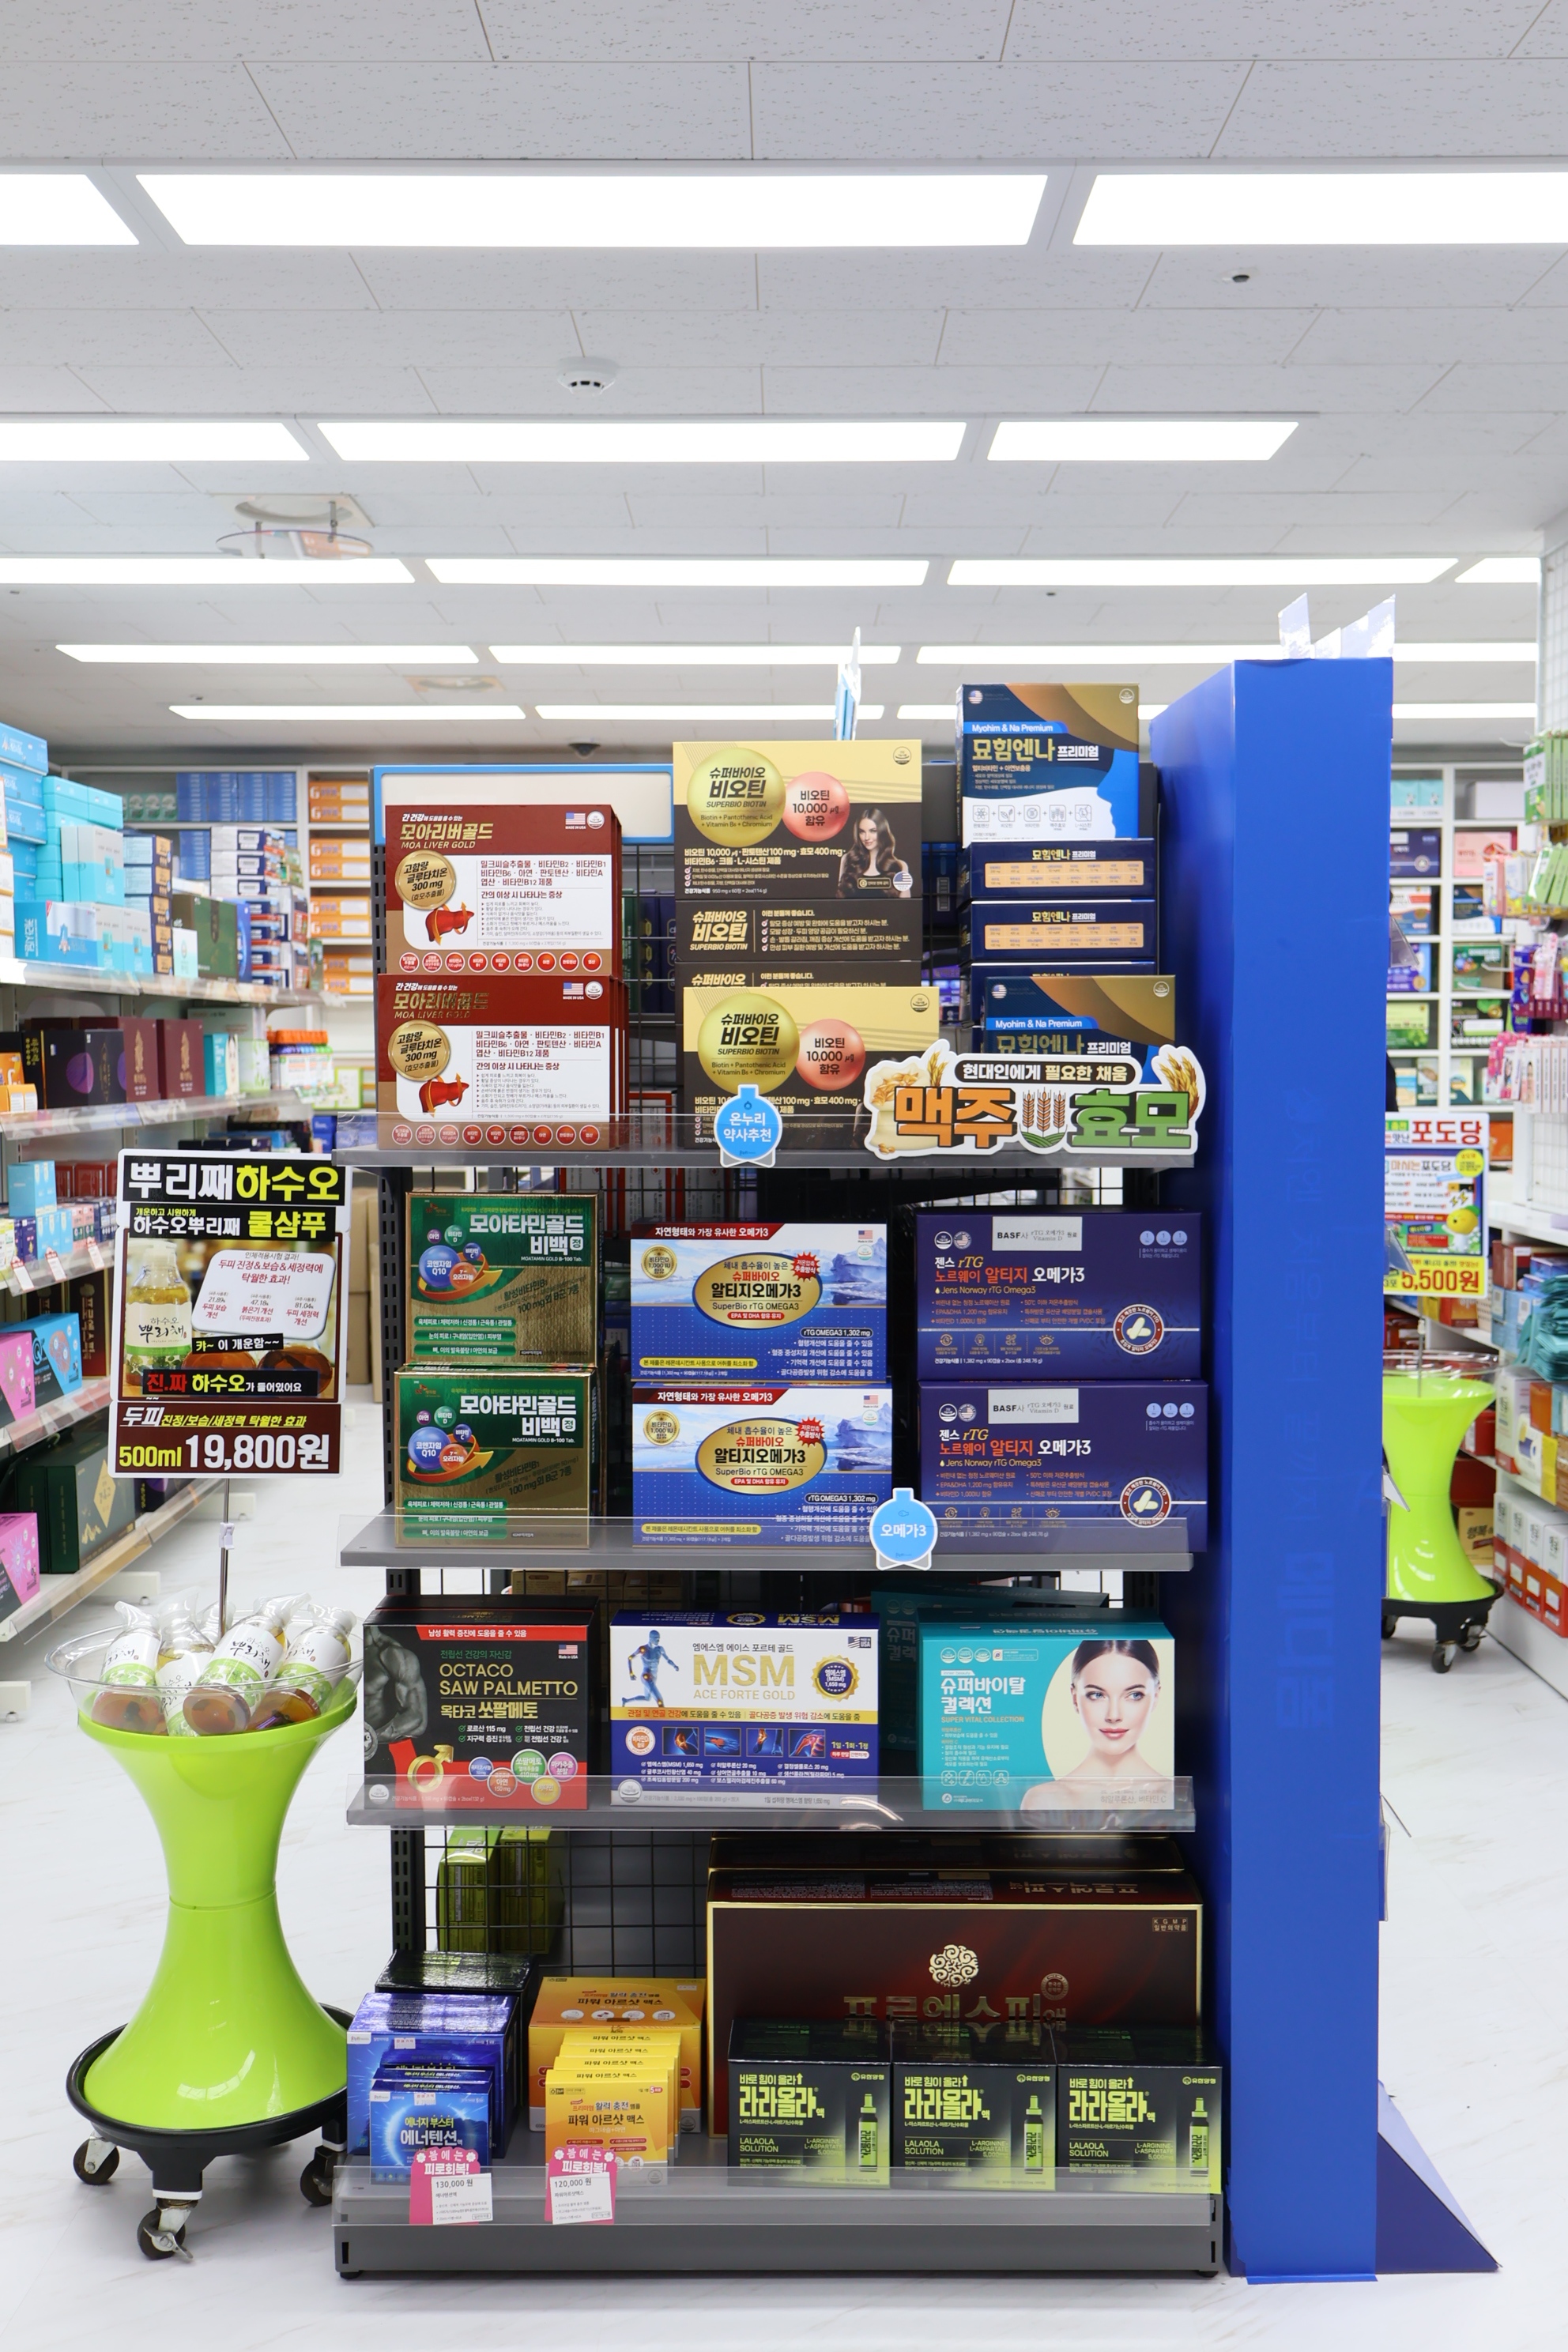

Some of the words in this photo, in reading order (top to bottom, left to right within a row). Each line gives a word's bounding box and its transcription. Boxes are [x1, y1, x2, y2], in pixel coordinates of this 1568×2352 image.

[972, 738, 1055, 761] 묘힘엔나
[1057, 745, 1099, 758] 프리미엄
[710, 767, 766, 779] 슈퍼바이오
[710, 780, 766, 799] 비오틴
[801, 790, 830, 801] 비오틴
[793, 803, 827, 815] 10,000
[805, 816, 824, 827] 함유
[400, 823, 493, 840] 모아리버골드
[1032, 850, 1070, 860] 묘힘엔나
[404, 861, 429, 874] 고함량
[481, 860, 531, 869] 밀크씨슬추출물
[538, 860, 569, 869] 비타민B2
[576, 860, 606, 869] 비타민B1
[407, 869, 448, 884] 글루타치온
[481, 869, 511, 877] 비타민B6
[518, 869, 533, 877] 아연
[540, 869, 569, 877] 판토텐산
[576, 869, 603, 877] 비타민A
[412, 880, 428, 891] 300
[429, 880, 443, 891] mg
[692, 910, 747, 923] 슈퍼바이오
[692, 923, 748, 942] 비오틴
[721, 1013, 778, 1026] 슈퍼바이오
[397, 1031, 423, 1045] 고함량
[721, 1027, 779, 1046] 비오틴
[401, 1038, 442, 1054] 글루타치온
[405, 1051, 421, 1062] 300
[423, 1050, 437, 1061] mg
[963, 1063, 1041, 1081] 현대인에게
[1045, 1065, 1092, 1081] 필요한
[1096, 1065, 1127, 1081] 채움
[729, 1112, 766, 1125] 온누리
[894, 1086, 1020, 1148] 맥주
[1070, 1088, 1192, 1148] 효모
[723, 1129, 771, 1142] 약사추천
[1412, 1121, 1482, 1144] 포도당
[136, 1208, 165, 1216] 개운하고
[167, 1208, 196, 1217] 시원하게
[134, 1216, 240, 1236] 하수오뿌리째
[248, 1211, 326, 1238] 쿨샴푸
[469, 1215, 584, 1234] 모아타민골드
[655, 1227, 695, 1237] 자연형태와
[714, 1227, 737, 1237] 유사한
[739, 1227, 769, 1237] 오메가3
[530, 1236, 568, 1255] 비백
[218, 1259, 235, 1269] 두피
[723, 1261, 738, 1270] 체내
[741, 1261, 771, 1270] 흡수율이
[773, 1261, 788, 1270] 높은
[935, 1257, 955, 1268] 젠스
[958, 1256, 983, 1268] rTG
[241, 1273, 268, 1283] 탁월한
[268, 1274, 291, 1285] 효과!
[733, 1272, 780, 1282] 슈퍼바이오
[935, 1270, 980, 1283] 노르웨이
[985, 1268, 1027, 1283] 알티지
[1032, 1267, 1085, 1283] 오메가3
[1401, 1270, 1479, 1293] 5,500원
[711, 1283, 801, 1298] 알티지오메가3
[941, 1286, 958, 1295] Jens
[959, 1286, 987, 1295] Norway
[989, 1286, 1001, 1295] rTG
[1003, 1286, 1036, 1295] Omega3
[712, 1302, 748, 1311] SuperBio
[765, 1302, 799, 1310] OMEGA3
[218, 1340, 228, 1351] 이
[460, 1395, 576, 1415] 모아타민골드
[249, 1416, 282, 1427] 탁월한
[283, 1416, 307, 1427] 효과
[522, 1417, 560, 1437] 비백
[119, 1446, 182, 1468] 500ml
[185, 1434, 330, 1471] 19,800원
[880, 1524, 927, 1538] 오메가3
[440, 1650, 463, 1659] 전립선
[465, 1650, 488, 1659] 건강의
[489, 1650, 512, 1659] 자신감
[692, 1643, 724, 1652] 엠에스엠
[778, 1644, 793, 1653] 골드
[439, 1664, 513, 1677] OCTACO
[693, 1654, 795, 1687] MSM
[439, 1681, 478, 1695] SAW
[484, 1681, 579, 1696] PALMETTO
[940, 1677, 1026, 1695] 슈퍼바이탈
[693, 1690, 717, 1699] ACE
[721, 1690, 760, 1700] FORTE
[763, 1690, 795, 1701] GOLD
[441, 1705, 476, 1719] 옥타코
[478, 1702, 538, 1719] 쏘팔메토
[940, 1696, 991, 1714] 컬렉션
[405, 2117, 428, 2128] 에너지
[430, 2117, 454, 2128] 부스터
[568, 2115, 589, 2125] 파워
[627, 2116, 644, 2124] 맥스
[424, 2163, 469, 2175] 피로회복!
[562, 2161, 607, 2173] 피로회복!
[435, 2180, 465, 2188] 130,000
[554, 2179, 583, 2188] 120,000
